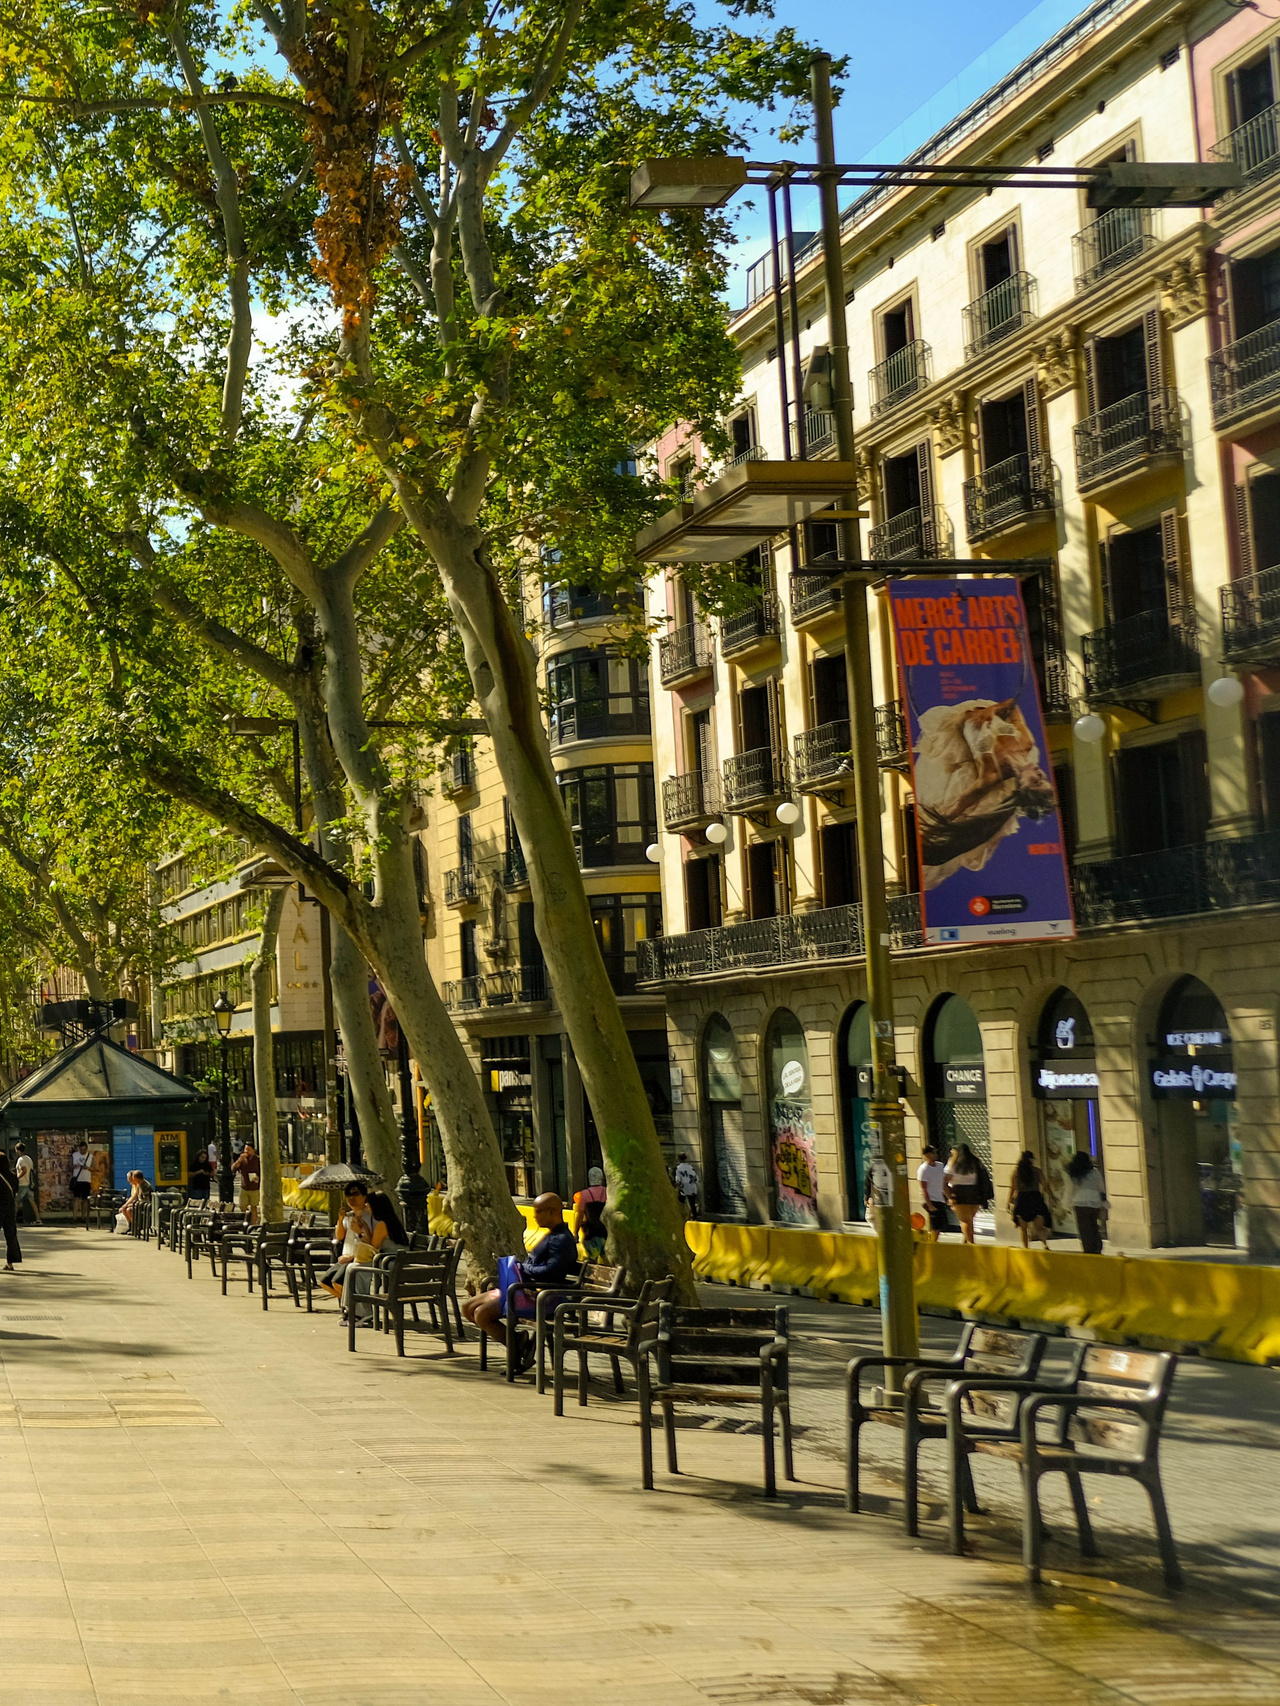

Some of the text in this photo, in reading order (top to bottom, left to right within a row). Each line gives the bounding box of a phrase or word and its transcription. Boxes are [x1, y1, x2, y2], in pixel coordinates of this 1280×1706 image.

[895, 592, 1020, 628] MERCÈ ARTS
[900, 629, 934, 666] DE
[291, 884, 309, 971] YAL
